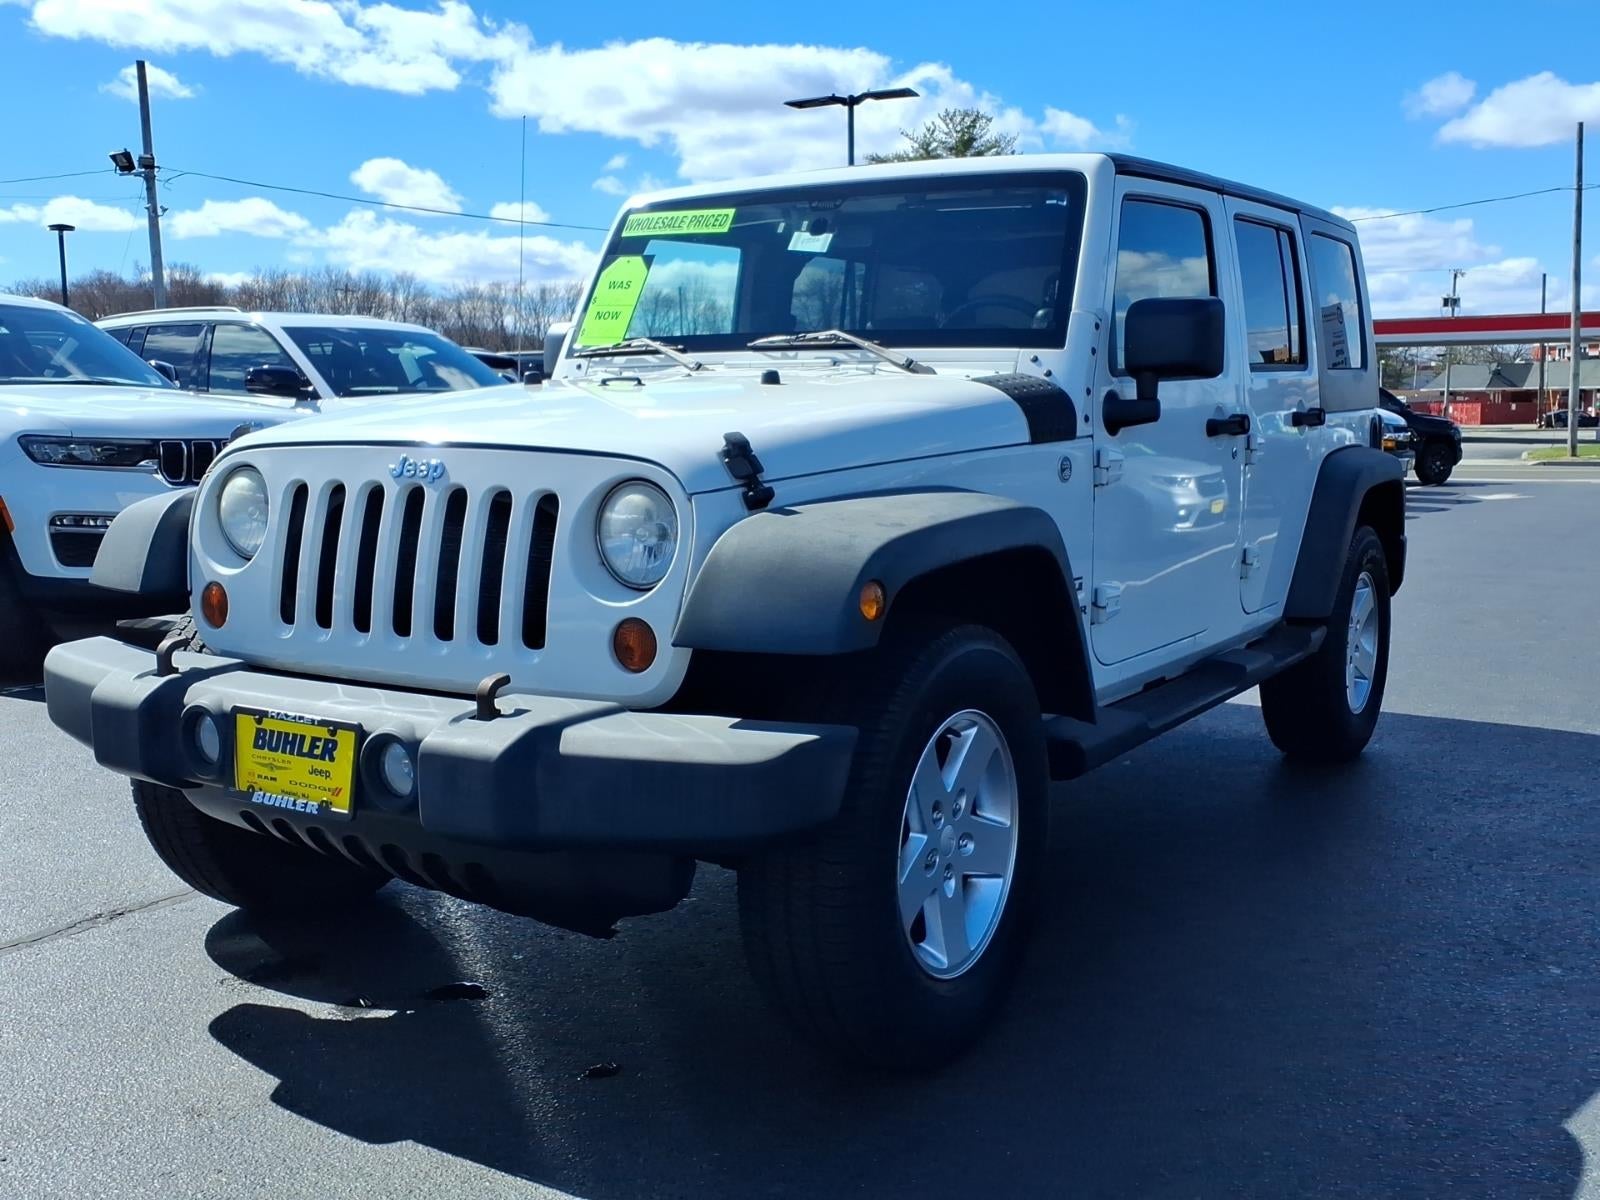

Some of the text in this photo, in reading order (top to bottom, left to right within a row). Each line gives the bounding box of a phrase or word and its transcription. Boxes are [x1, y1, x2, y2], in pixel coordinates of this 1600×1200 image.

[625, 213, 730, 232] WHOLESALE PRICED
[608, 280, 632, 290] WAS
[594, 310, 621, 321] NOW
[388, 453, 445, 484] Jeep
[252, 727, 339, 763] BUHLER
[257, 773, 278, 782] RAM
[308, 764, 332, 781] Jeep
[289, 780, 336, 793] DODGE
[251, 791, 319, 814] BUHLER
